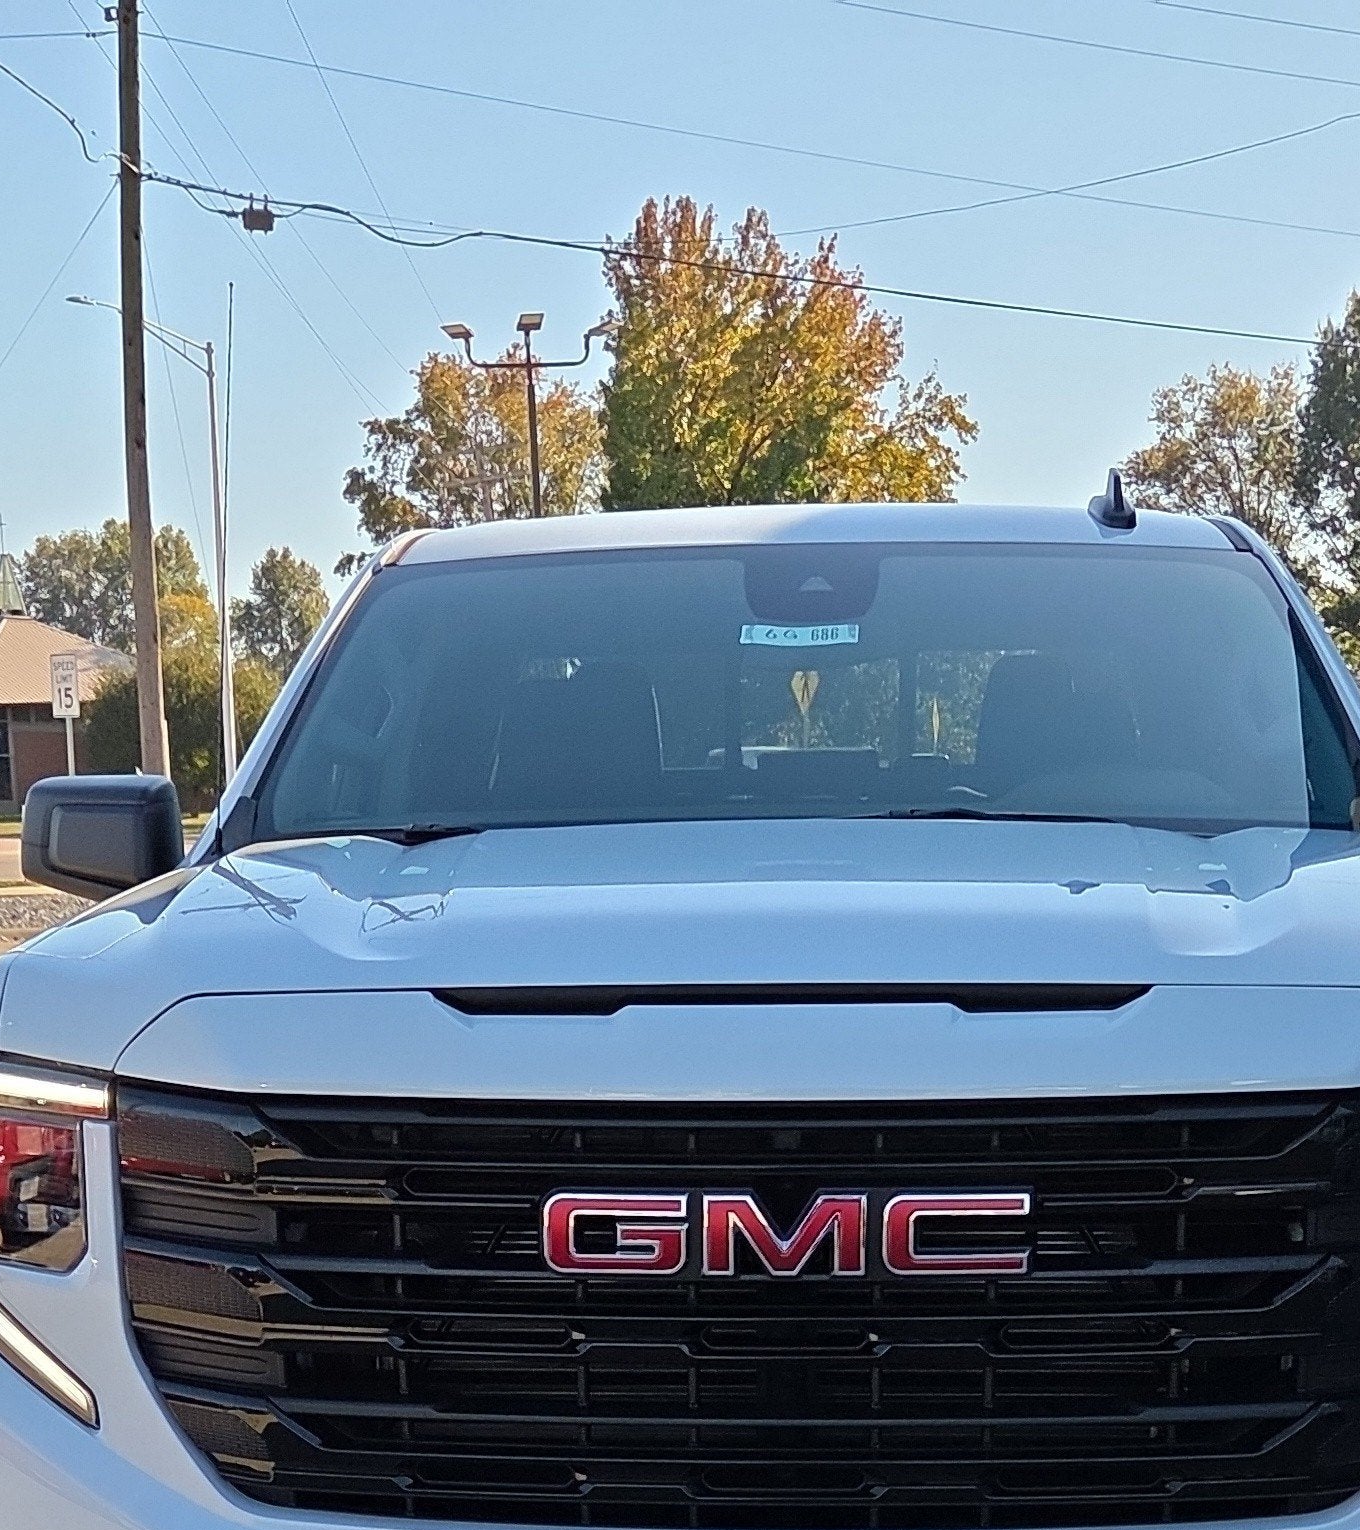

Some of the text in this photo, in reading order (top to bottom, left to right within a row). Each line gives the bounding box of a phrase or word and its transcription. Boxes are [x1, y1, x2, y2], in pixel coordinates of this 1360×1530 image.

[53, 661, 74, 672] SPEED
[57, 687, 74, 709] 15
[542, 1192, 1032, 1277] GMC
